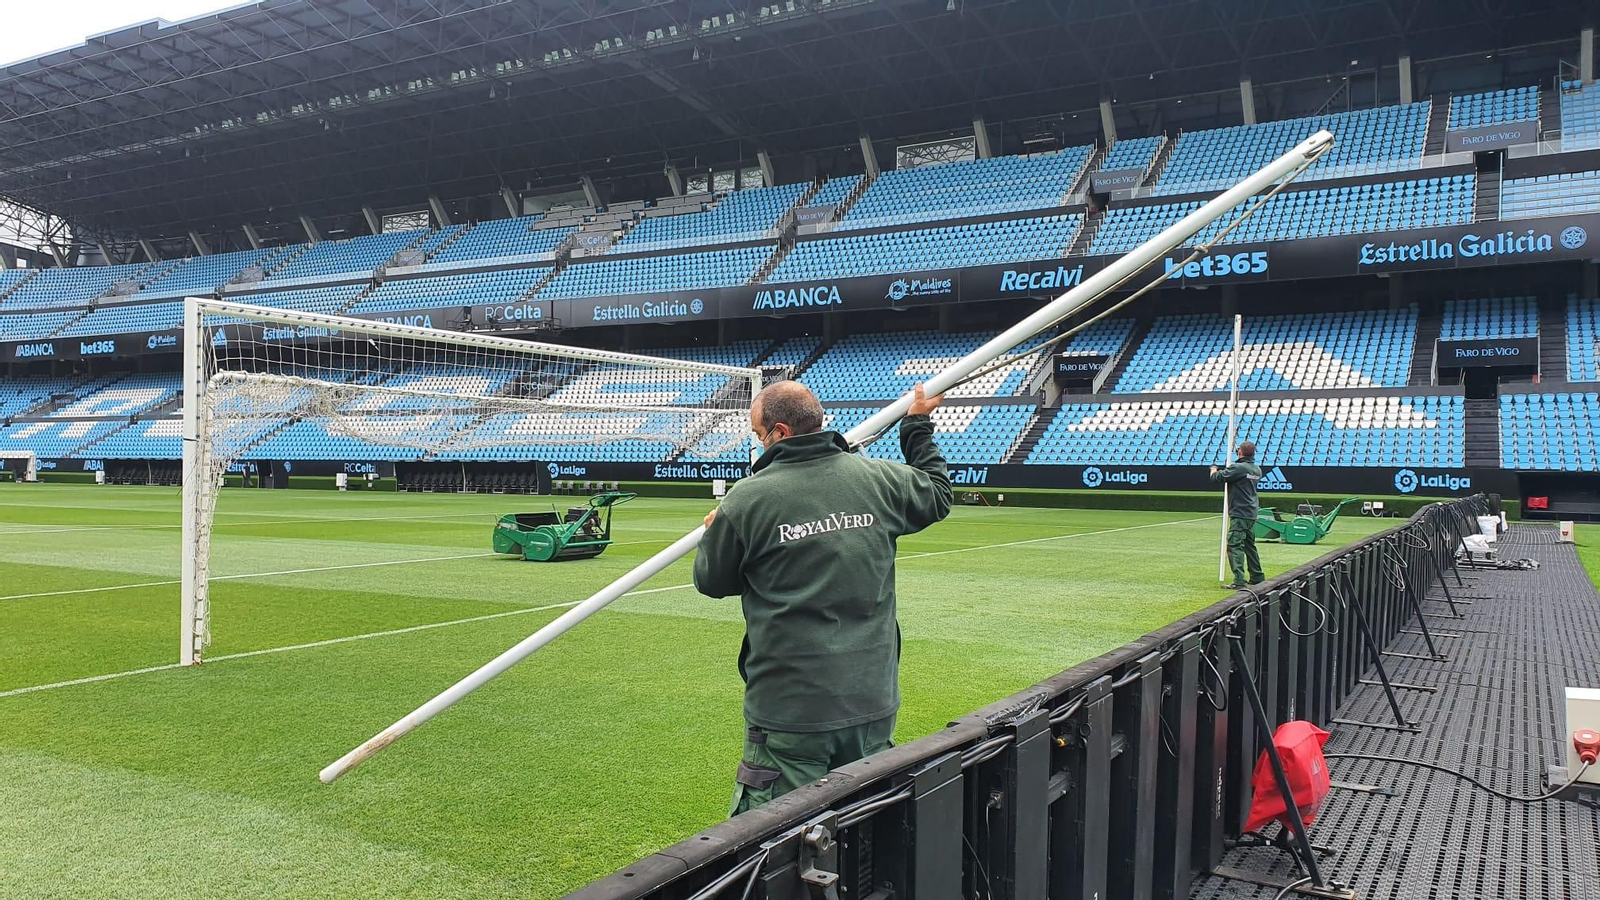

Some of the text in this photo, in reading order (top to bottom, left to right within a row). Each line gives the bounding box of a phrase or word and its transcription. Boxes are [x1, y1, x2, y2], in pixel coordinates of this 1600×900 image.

[1461, 130, 1521, 146] FARO DE VIGO
[1095, 178, 1111, 187] FARO
[1359, 228, 1553, 266] Estrella Galicia
[1163, 250, 1269, 280] bet365
[911, 277, 952, 292] Maldives
[1000, 264, 1084, 292] Recalvi
[592, 299, 688, 322] Estrella Galicia
[262, 325, 295, 341] Estrella
[80, 340, 115, 355] bet365
[1455, 346, 1520, 358] FARO DE VIGO
[1059, 363, 1078, 371] FARO
[1078, 363, 1088, 371] DE
[559, 465, 586, 477] LaLiga
[653, 463, 743, 479] Estrella Galicia
[1104, 470, 1148, 486] LaLiga
[1256, 480, 1293, 491] adidas
[1420, 473, 1471, 491] LaLiga
